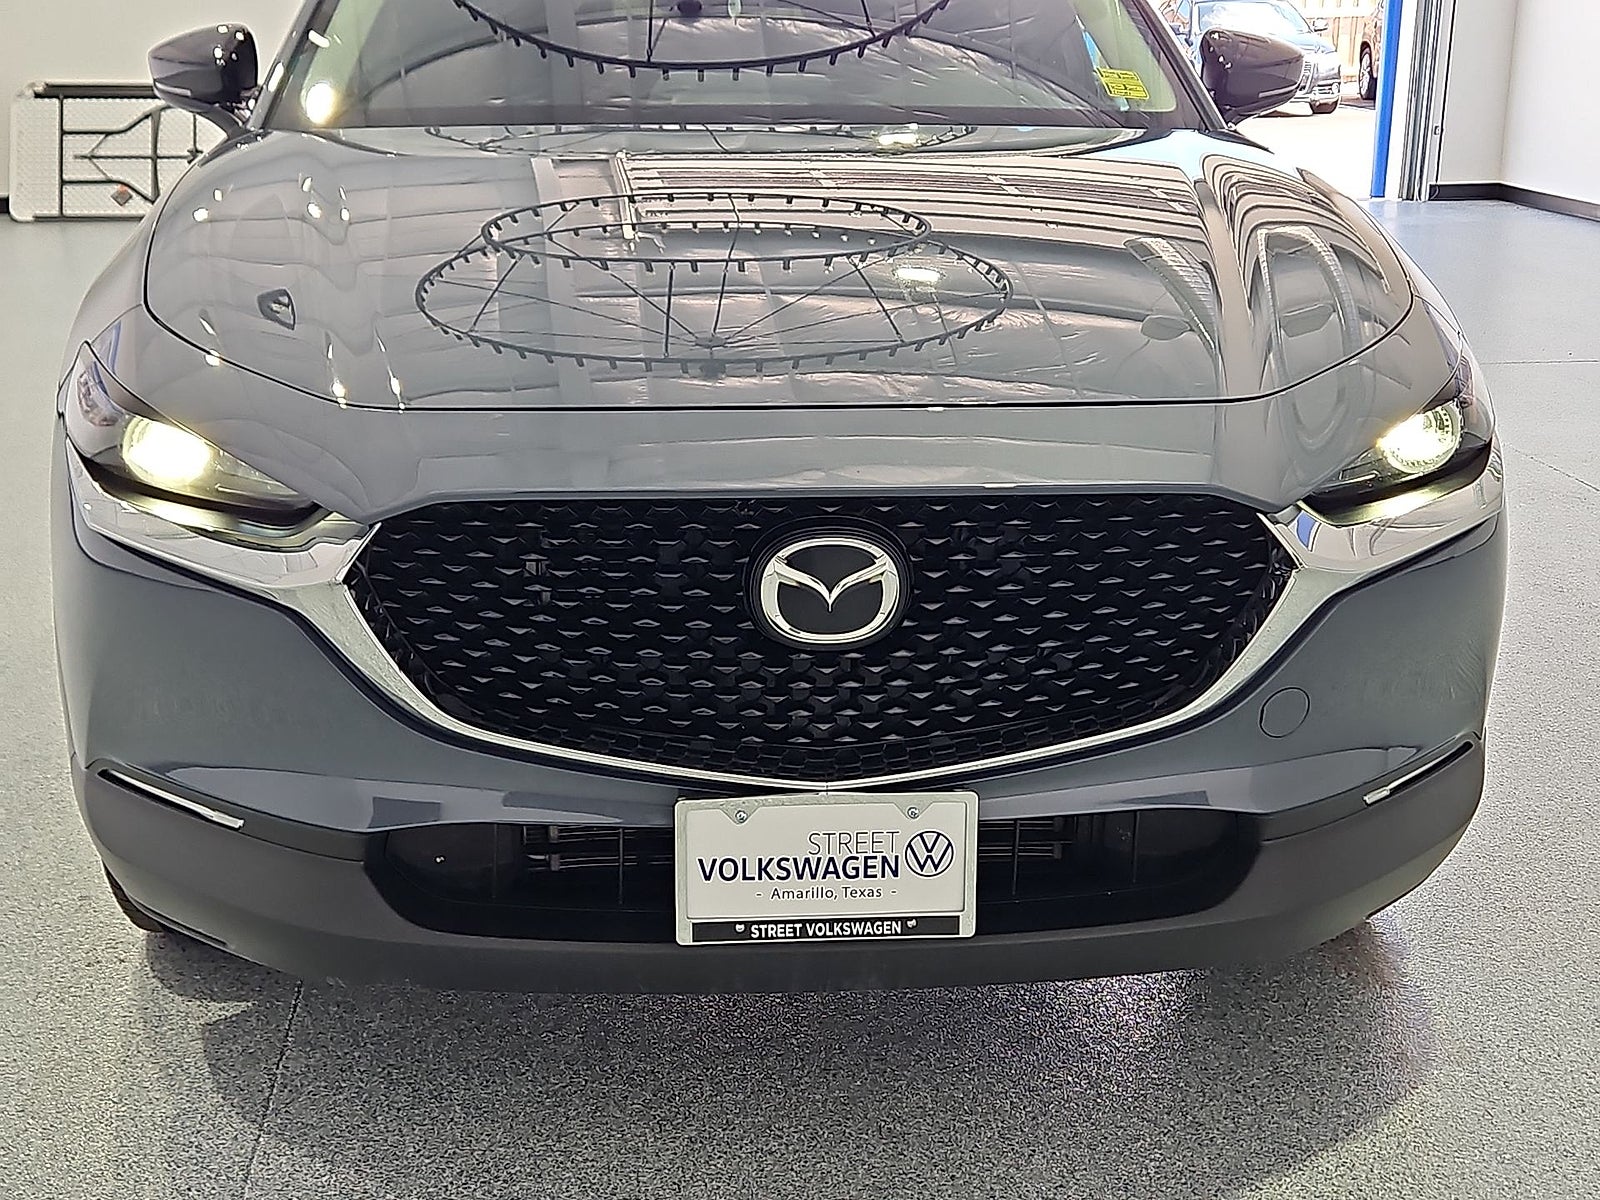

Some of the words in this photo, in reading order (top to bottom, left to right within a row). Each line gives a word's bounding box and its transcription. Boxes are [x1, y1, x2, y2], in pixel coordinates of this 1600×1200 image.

[808, 831, 900, 855] STREET
[698, 855, 900, 882] VOLKSWAGEN
[770, 886, 838, 901] Amarillo,
[842, 886, 882, 898] Texas
[751, 923, 802, 938] STREET
[806, 920, 902, 937] VOLKSWAGEN
